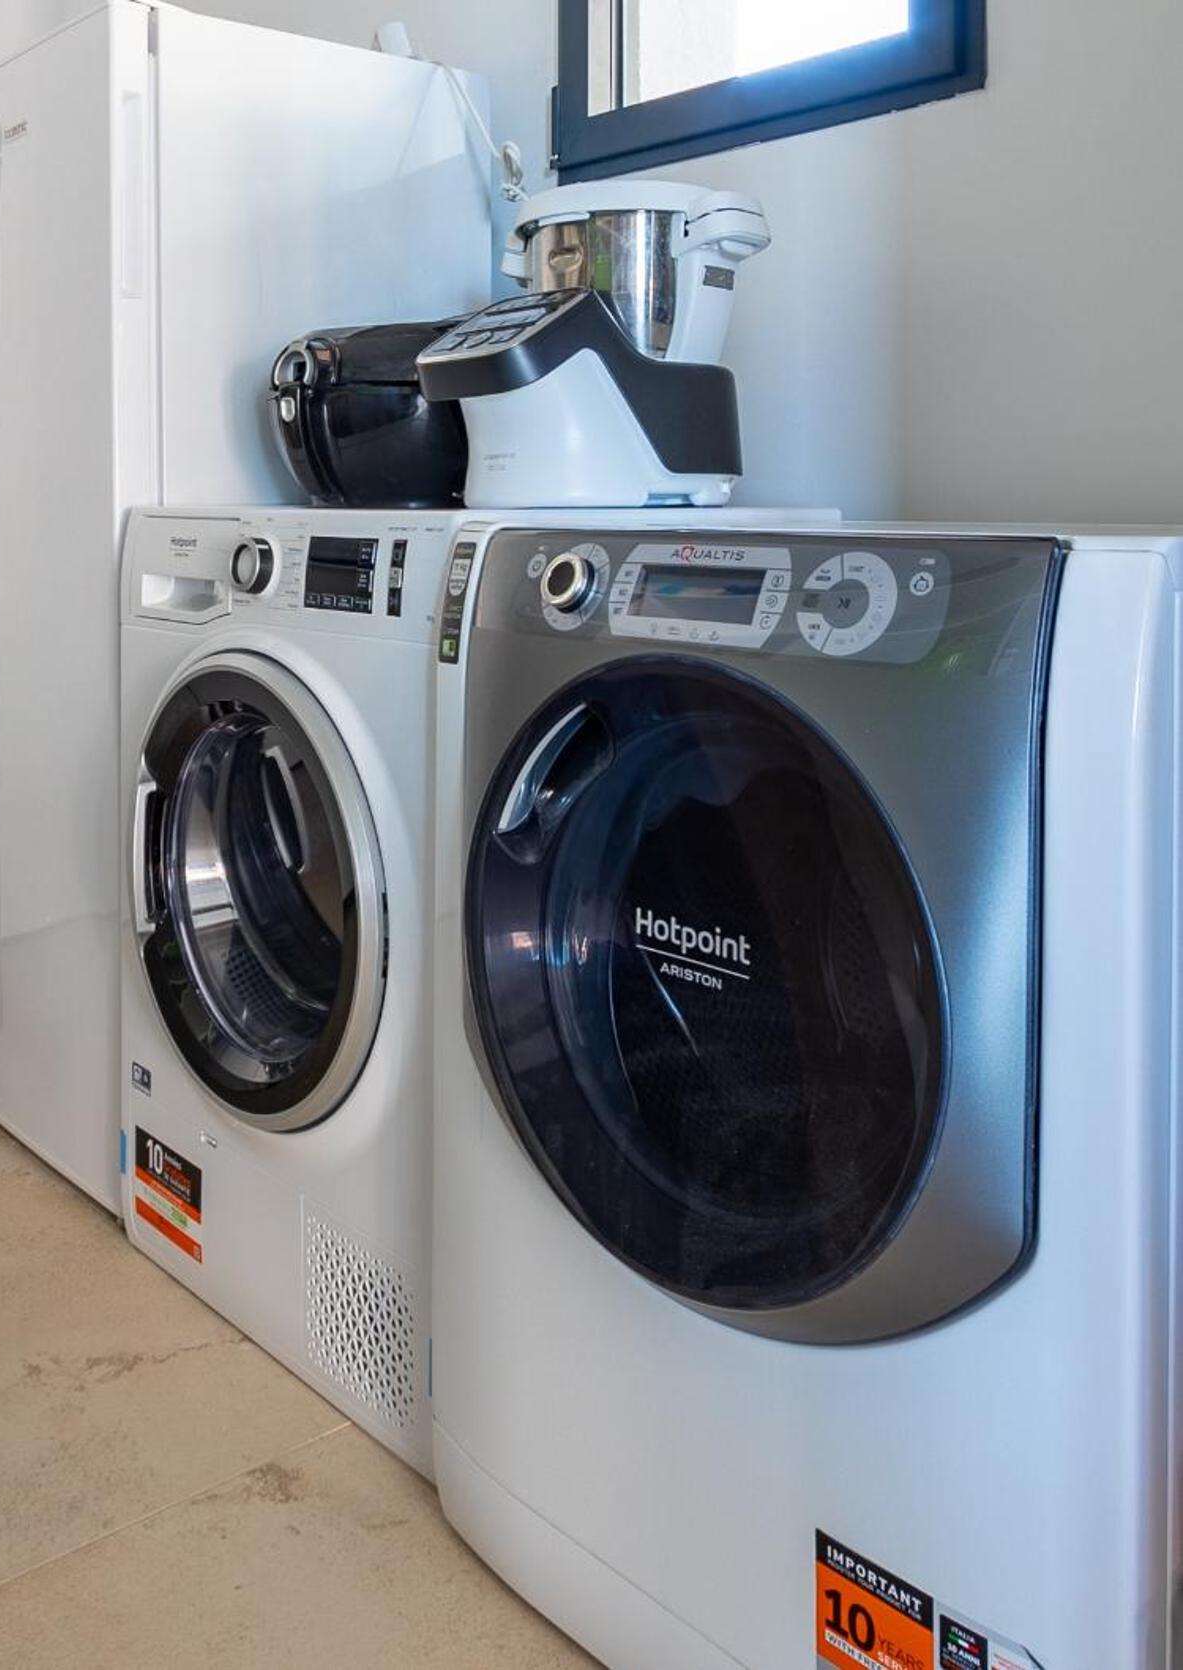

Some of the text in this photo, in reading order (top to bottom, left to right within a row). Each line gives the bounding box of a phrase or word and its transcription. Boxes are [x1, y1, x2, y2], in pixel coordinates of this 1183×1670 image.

[672, 545, 745, 561] AQUALTIS
[635, 906, 752, 966] Hotpoint
[659, 961, 723, 991] ARISTON
[146, 1138, 163, 1175] 10
[827, 1545, 922, 1611] IMPORTANT
[824, 1588, 876, 1653] 10
[877, 1635, 925, 1670] YEARS
